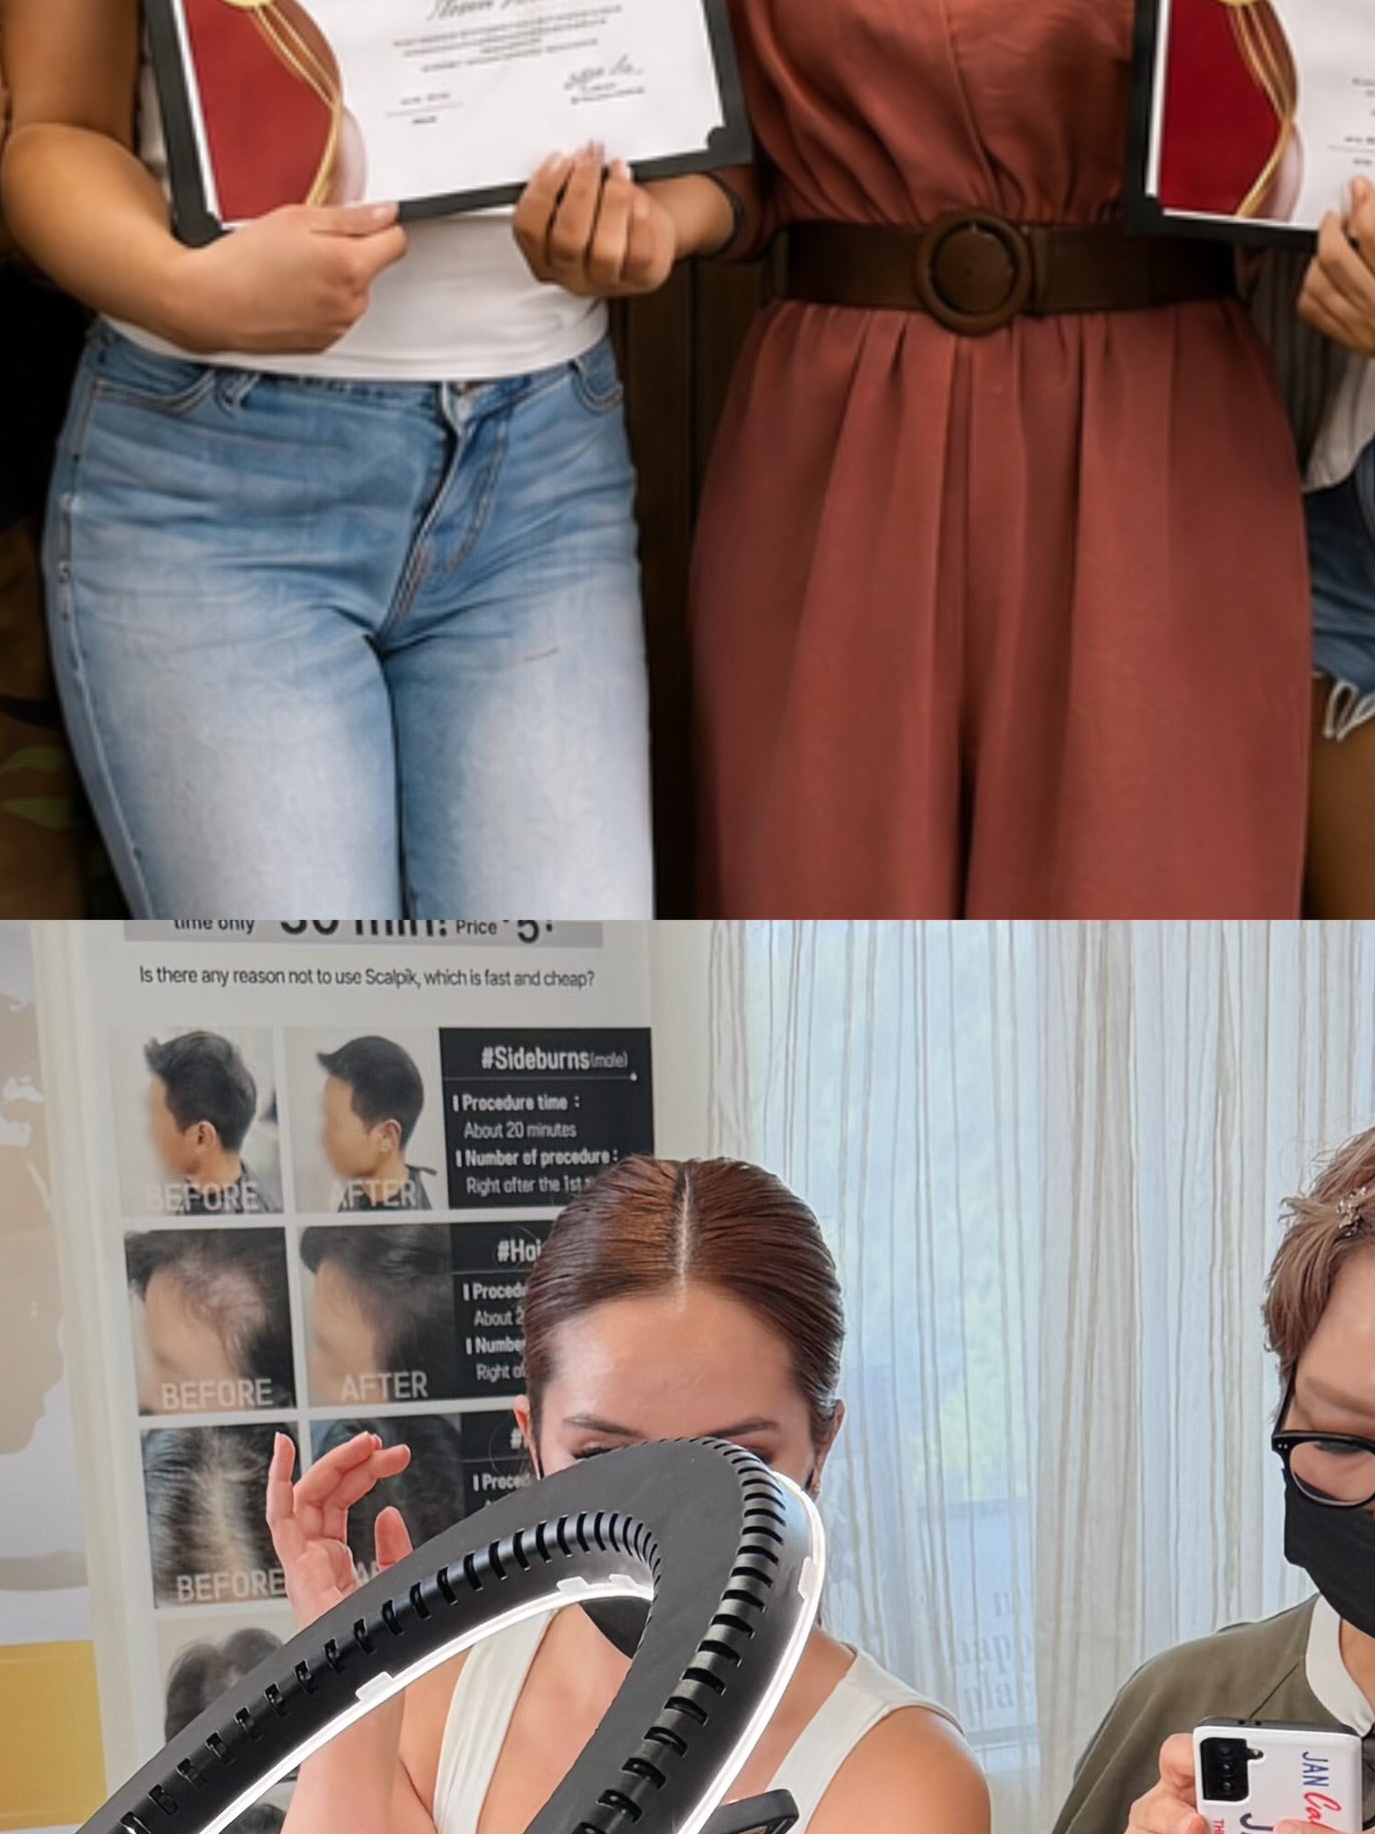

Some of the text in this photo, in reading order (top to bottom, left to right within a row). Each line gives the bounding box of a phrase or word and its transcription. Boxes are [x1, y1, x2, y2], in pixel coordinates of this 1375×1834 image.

[139, 965, 153, 983] Is
[156, 966, 198, 983] there
[201, 969, 229, 988] any
[233, 970, 285, 984] reason
[289, 969, 314, 984] not
[317, 969, 332, 985] to
[335, 971, 362, 985] use
[424, 969, 467, 986] which
[470, 969, 482, 986] is
[484, 969, 511, 986] fast
[514, 970, 541, 987] and
[544, 970, 595, 990] cheap?
[462, 1095, 534, 1111] Procedure
[537, 1095, 568, 1111] time
[464, 1122, 577, 1139] About 20 minutes
[465, 1149, 519, 1166] Number
[523, 1149, 537, 1165] of
[146, 1181, 259, 1213] BEFORE
[328, 1179, 417, 1208] AFTER
[466, 1177, 501, 1197] Right
[503, 1176, 536, 1193] after
[539, 1176, 561, 1192] the
[474, 1310, 513, 1327] About
[476, 1363, 510, 1383] Right
[161, 1378, 274, 1411] BEFORE
[340, 1371, 429, 1401] AFTER
[176, 1569, 285, 1603] BEFORE
[1302, 1751, 1329, 1787] JAN
